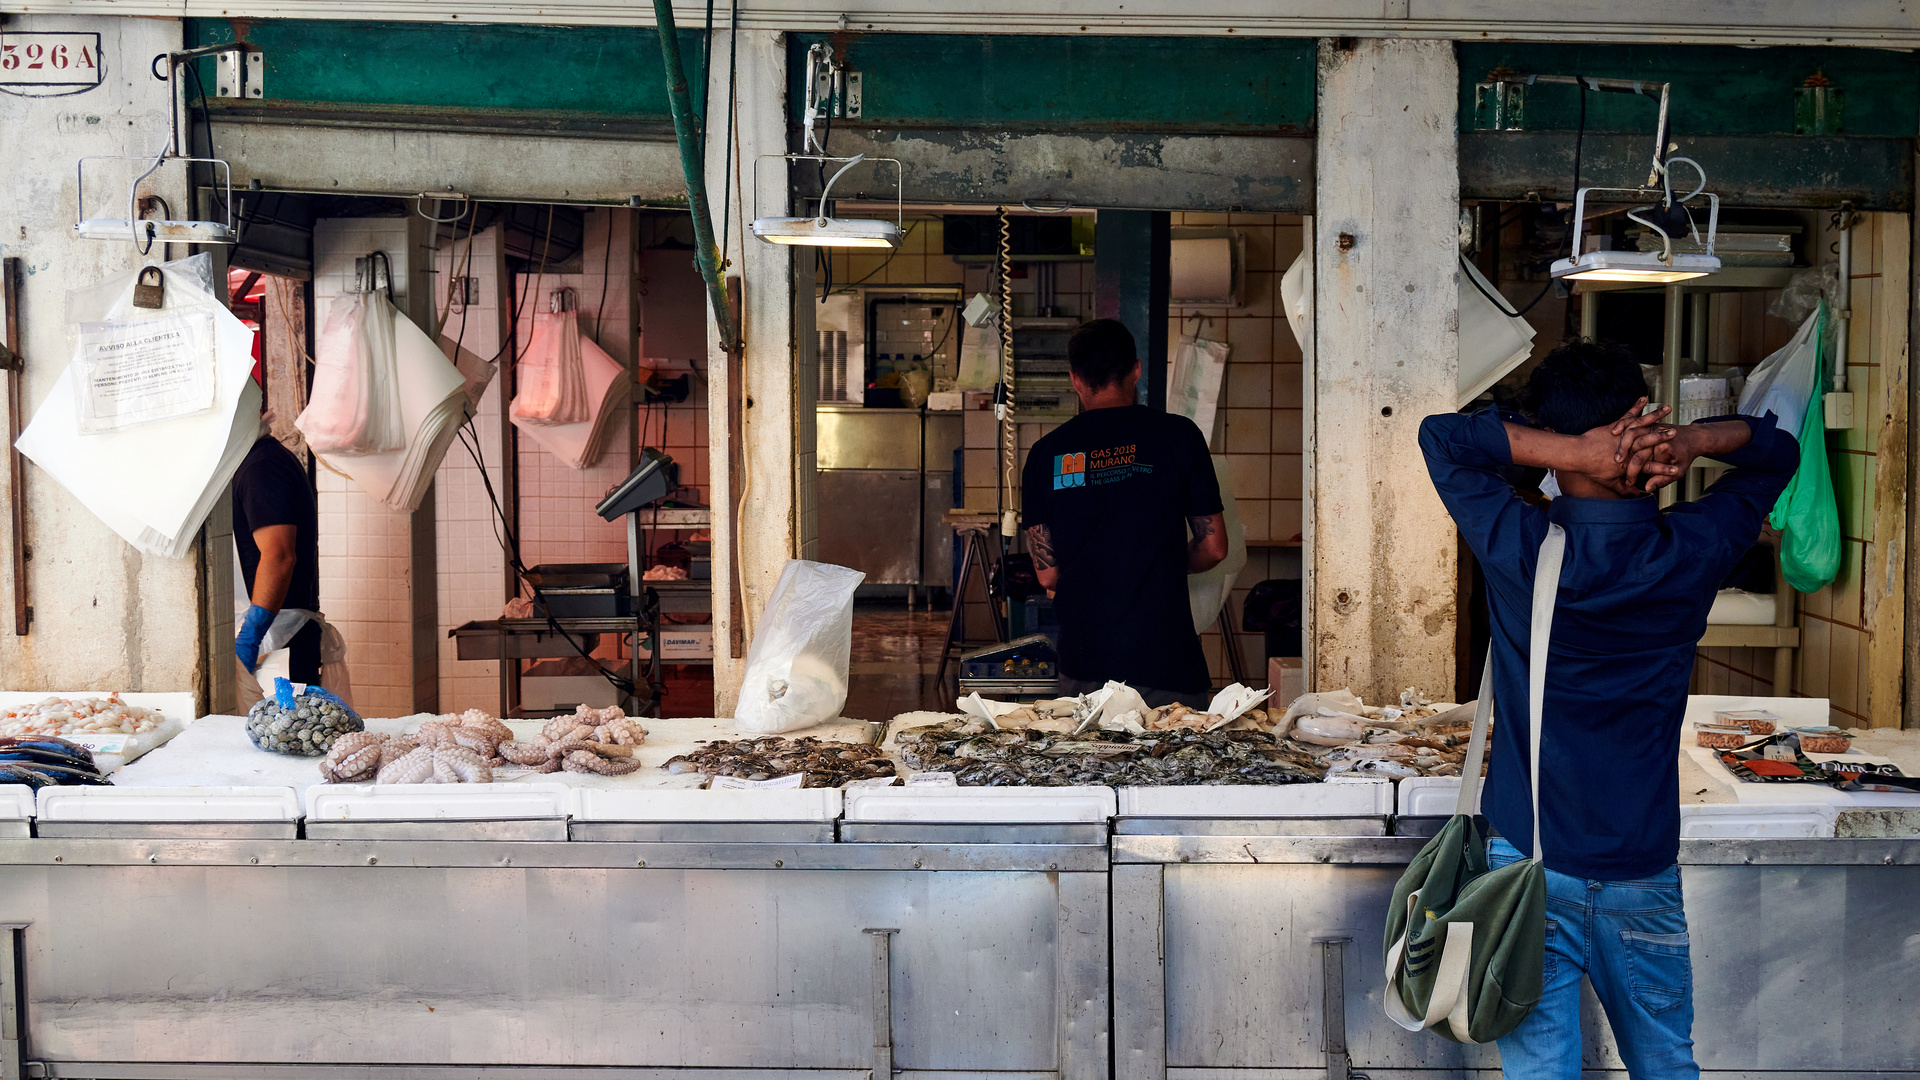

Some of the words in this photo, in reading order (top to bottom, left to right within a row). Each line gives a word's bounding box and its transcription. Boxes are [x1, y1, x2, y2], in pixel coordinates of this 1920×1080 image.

[3, 44, 96, 70] 326A
[99, 343, 125, 353] AVVISO
[126, 339, 143, 348] ALLA
[144, 331, 180, 344] CLIENTELA
[1090, 448, 1111, 458] GAS
[1114, 444, 1136, 456] 2018
[1090, 454, 1136, 469] MURANO
[1096, 468, 1126, 478] PERCORSO
[1103, 476, 1120, 484] GLASS
[1089, 743, 1138, 751] Seppioline
[751, 776, 800, 788] Moscardino
